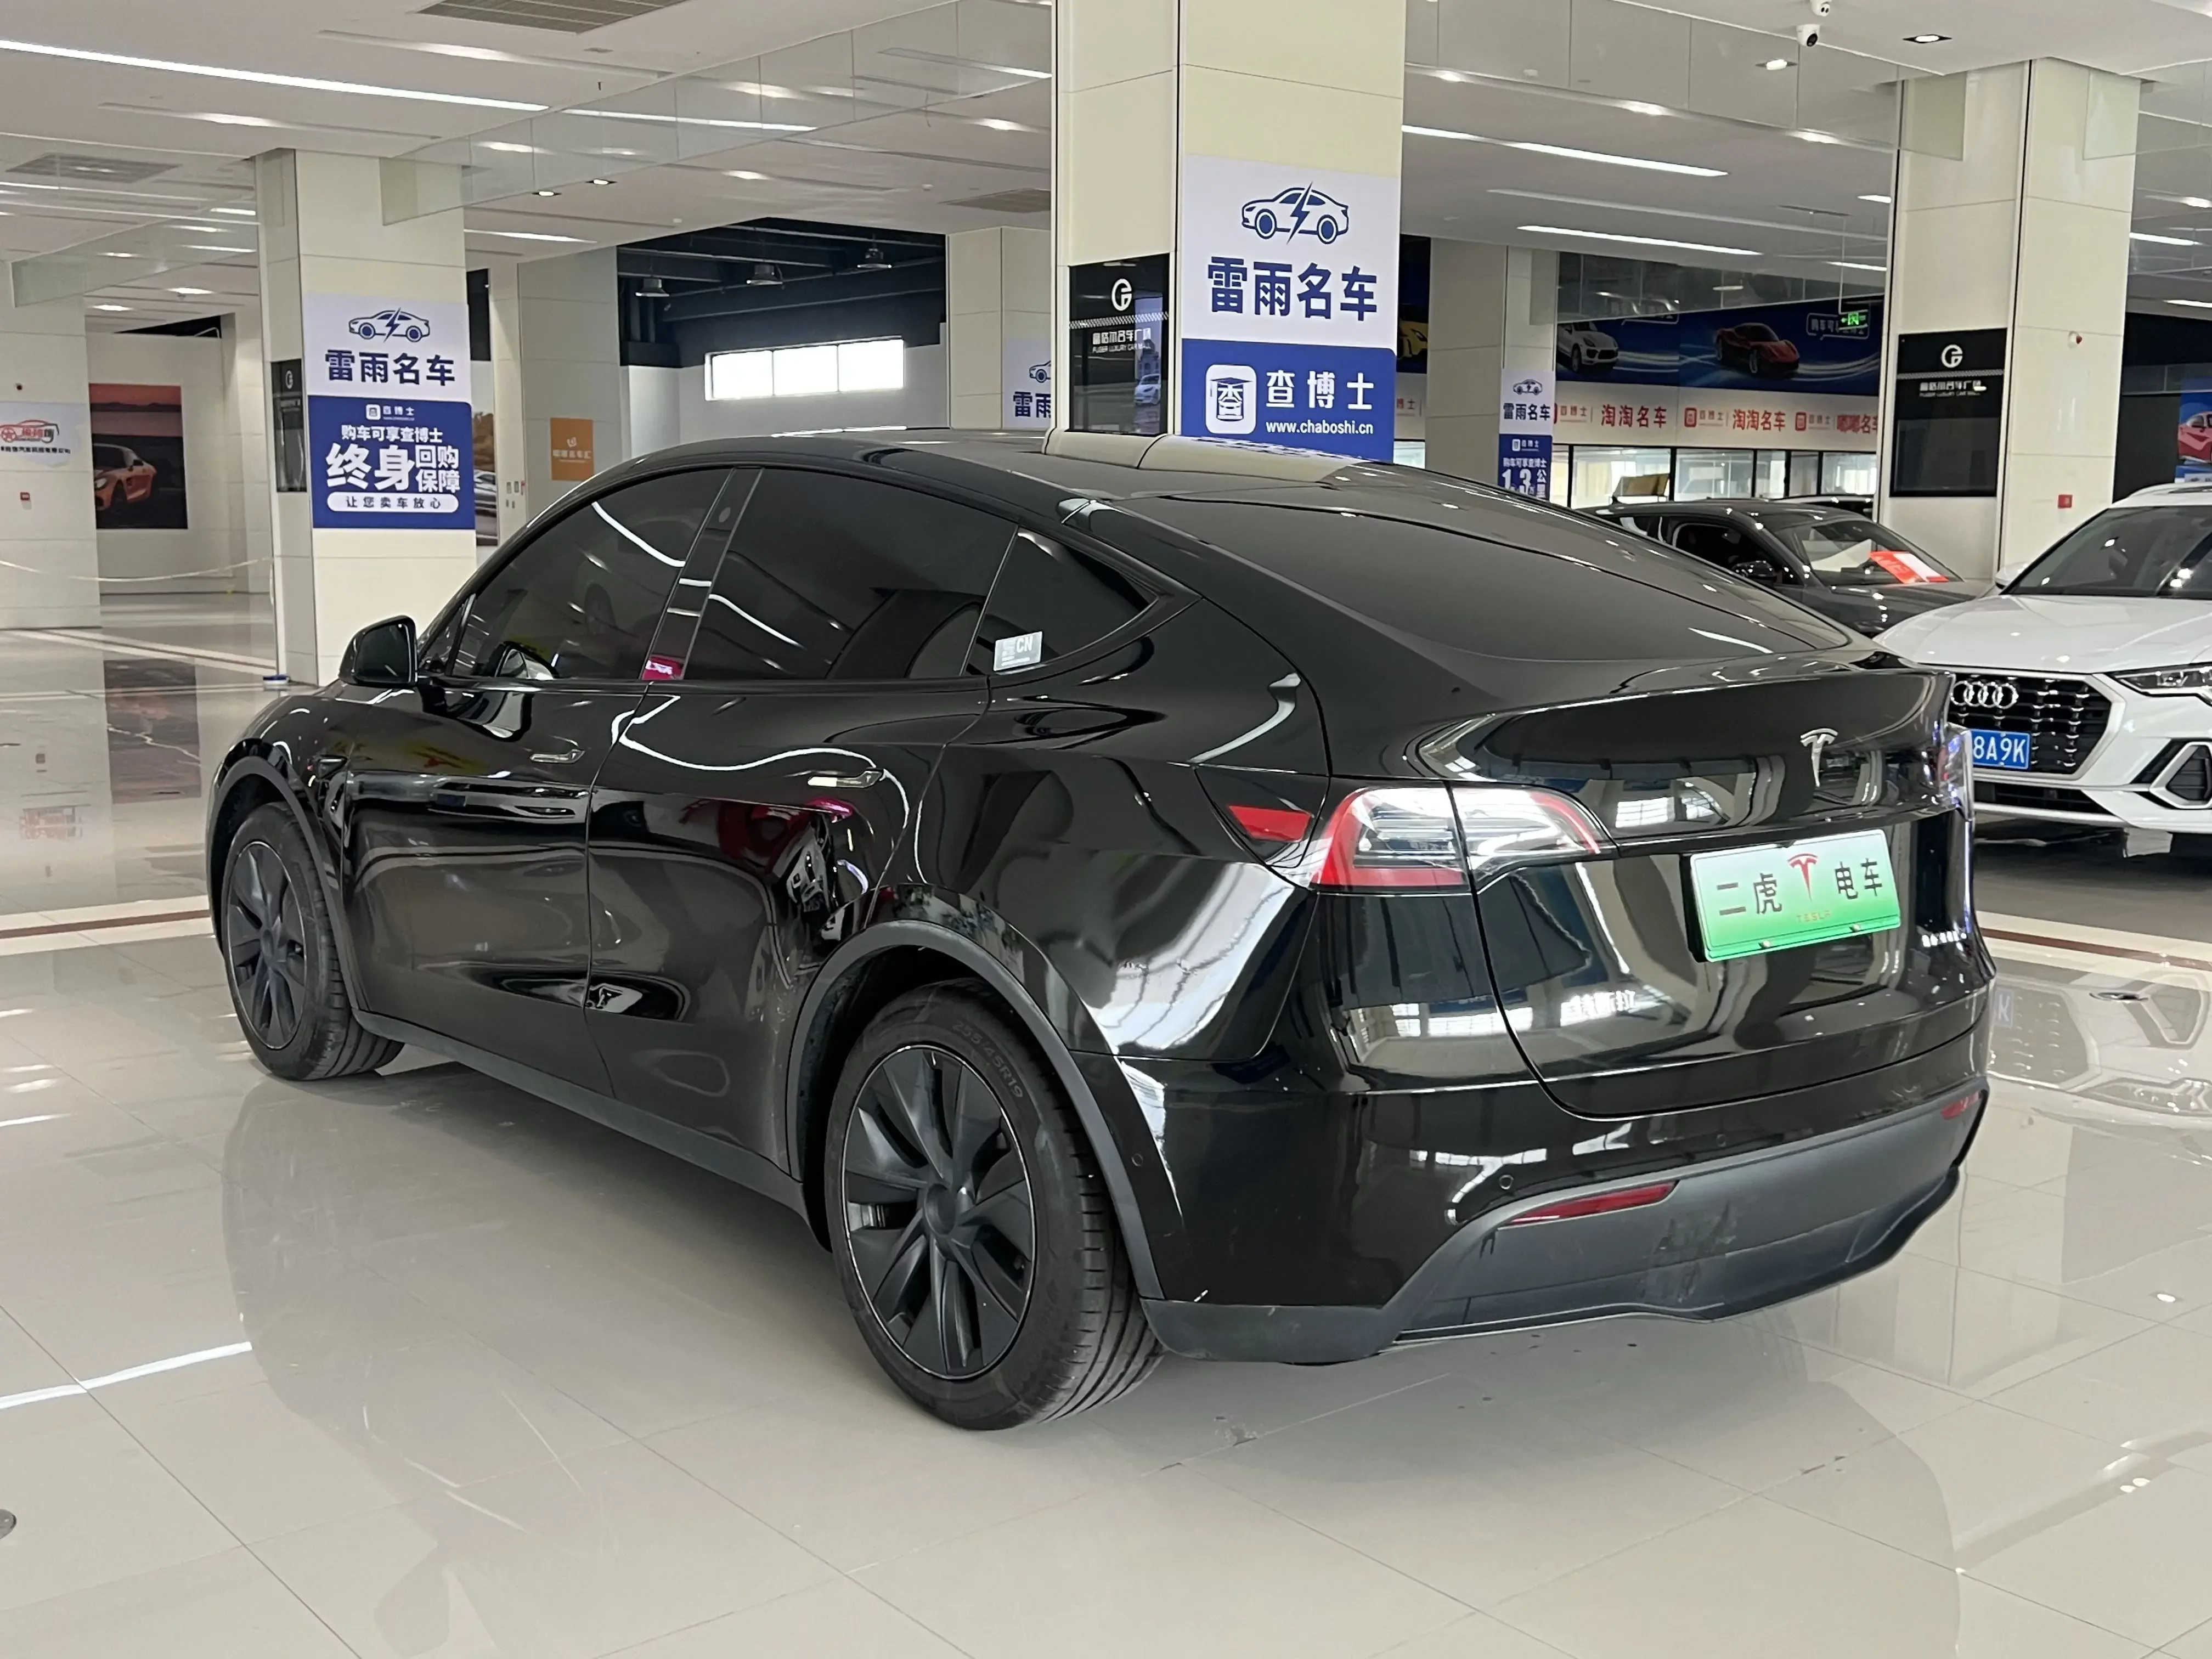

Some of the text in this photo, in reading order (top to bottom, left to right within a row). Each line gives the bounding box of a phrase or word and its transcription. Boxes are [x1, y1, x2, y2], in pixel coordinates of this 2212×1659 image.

[1208, 256, 1377, 321] 雷雨名车
[325, 349, 455, 386] 雷雨名车
[1266, 370, 1374, 410] 查博士
[1013, 391, 1051, 418] 雷雨
[1503, 403, 1550, 421] 雷雨名车
[1601, 404, 1667, 428] 淘淘名车
[1266, 420, 1374, 435] www.chaboshi.cn
[1733, 409, 1786, 432] 淘淘名车
[341, 425, 443, 443] 购车可享查博士
[326, 443, 415, 491] 终身
[415, 445, 459, 469] 回购
[416, 469, 460, 493] 保障
[1973, 736, 2026, 764] 8A9K
[1717, 873, 1782, 915] 二虎
[1834, 857, 1883, 900] 电车
